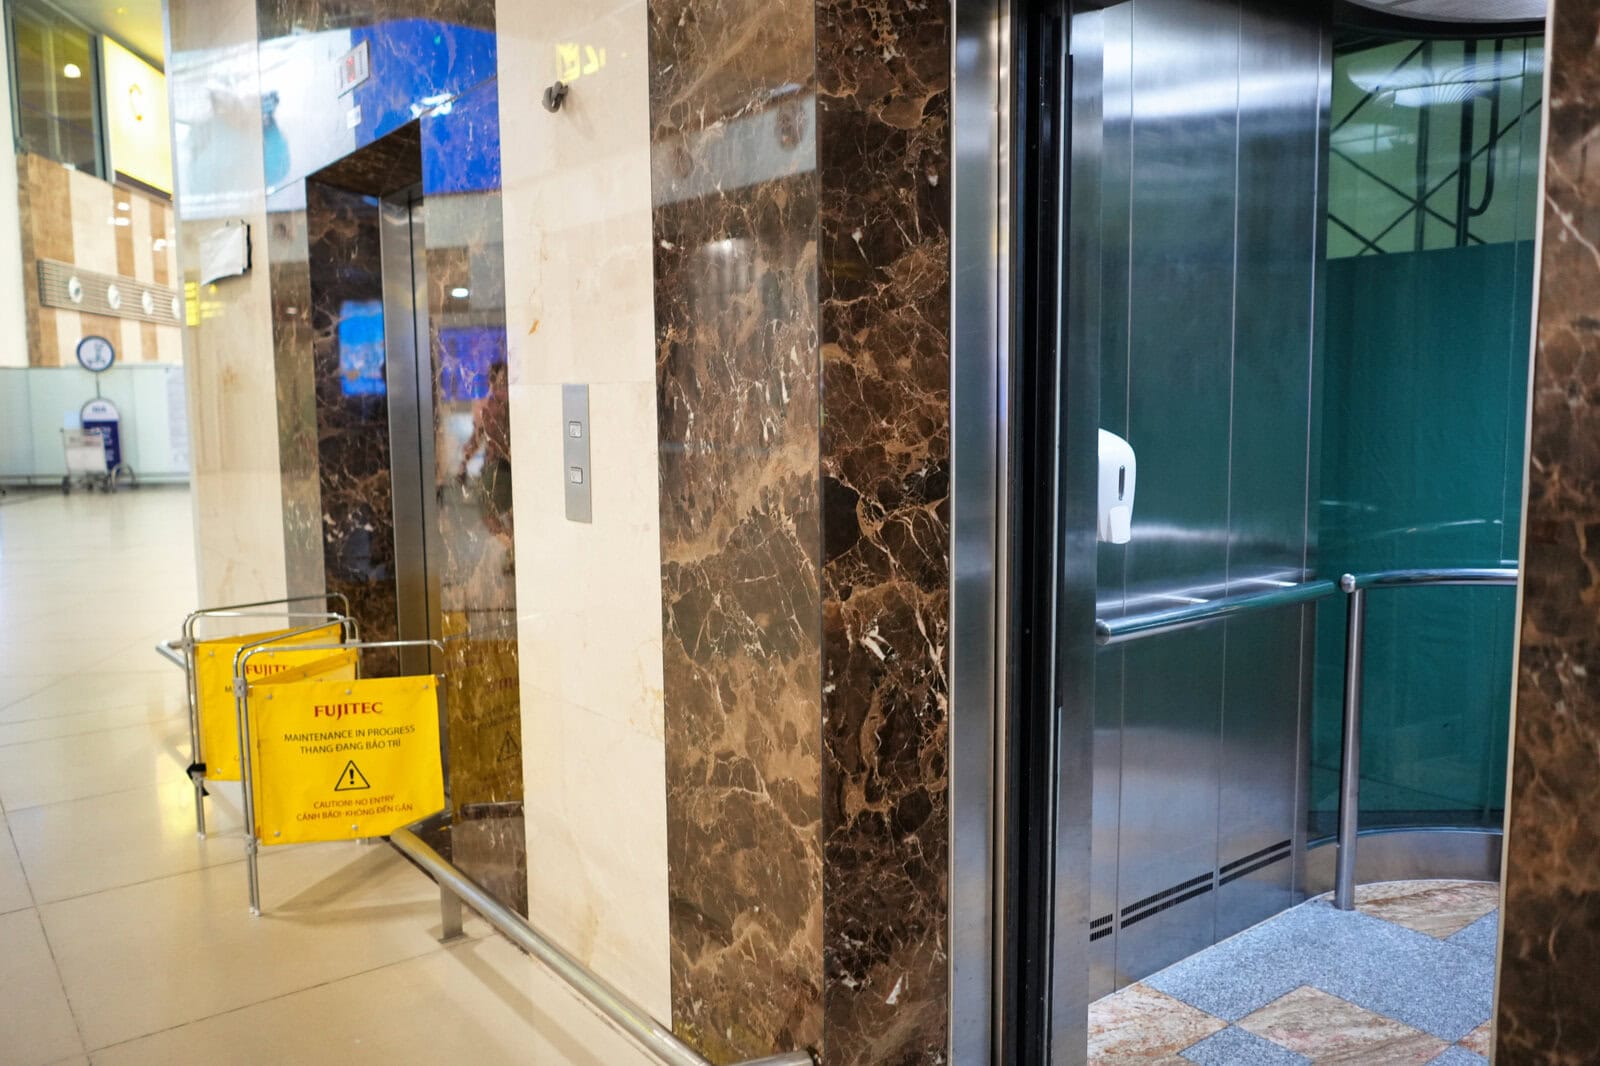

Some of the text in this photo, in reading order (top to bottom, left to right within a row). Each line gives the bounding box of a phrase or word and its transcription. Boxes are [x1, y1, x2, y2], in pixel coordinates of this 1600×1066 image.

[245, 664, 290, 676] FUJIT
[314, 702, 383, 720] FUJITEC
[284, 725, 415, 742] MAINTENANCE IN PROGRESS
[300, 744, 333, 755] THANG
[336, 741, 363, 753] ĐANG
[355, 798, 368, 807] NO
[369, 794, 395, 805] ENTRY
